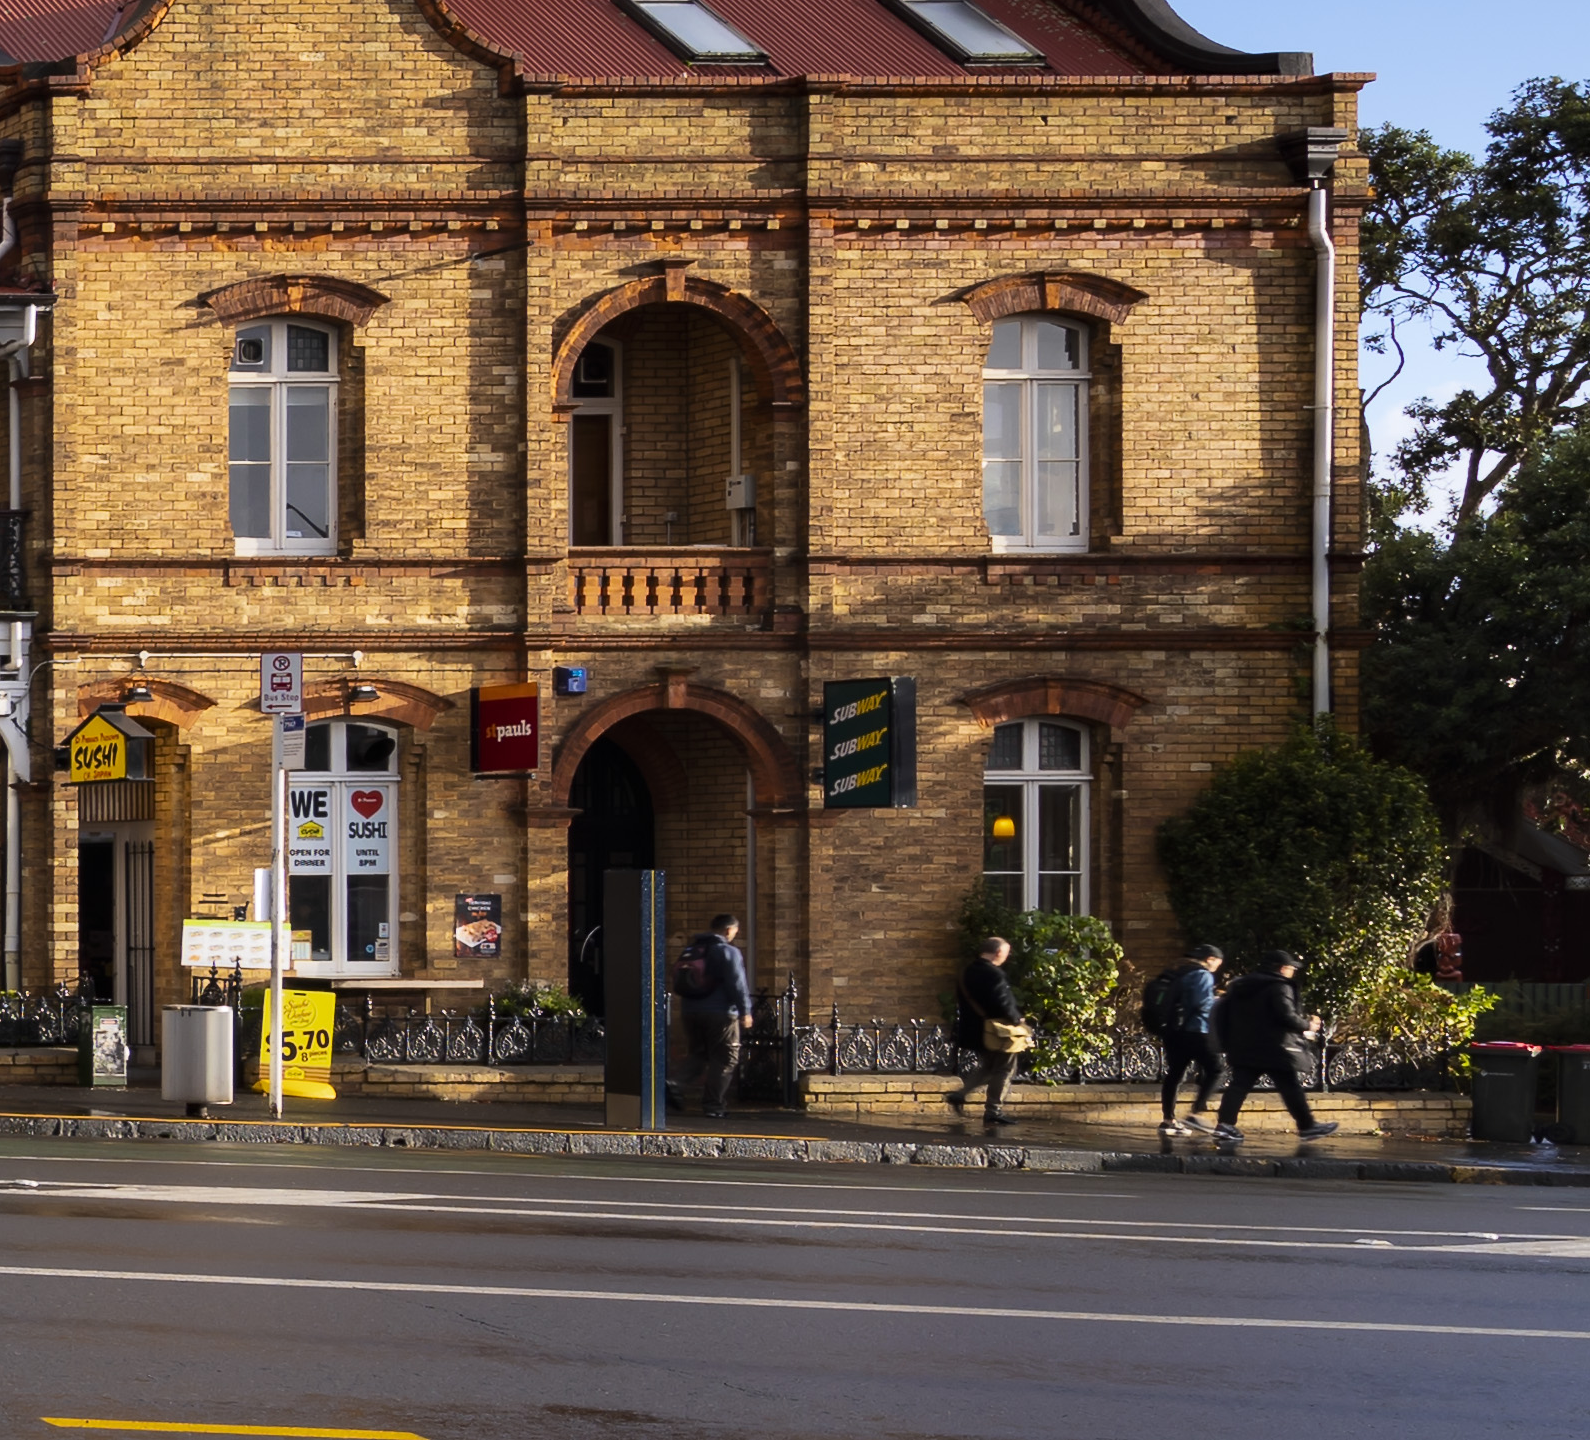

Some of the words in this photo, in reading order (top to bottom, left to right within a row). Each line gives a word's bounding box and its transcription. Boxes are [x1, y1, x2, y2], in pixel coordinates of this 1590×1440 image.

[281, 693, 299, 702] Stop
[829, 690, 888, 725] SUBWAY
[74, 743, 118, 770] SUSHI
[829, 727, 888, 760] SUBWAY
[829, 763, 888, 796] SUBWAY
[291, 790, 328, 818] WE
[348, 822, 387, 839] SUSHI
[289, 849, 311, 857] OPEN
[314, 849, 330, 857] FOR
[265, 1029, 330, 1062] 5.70
[301, 1052, 309, 1062] 8
